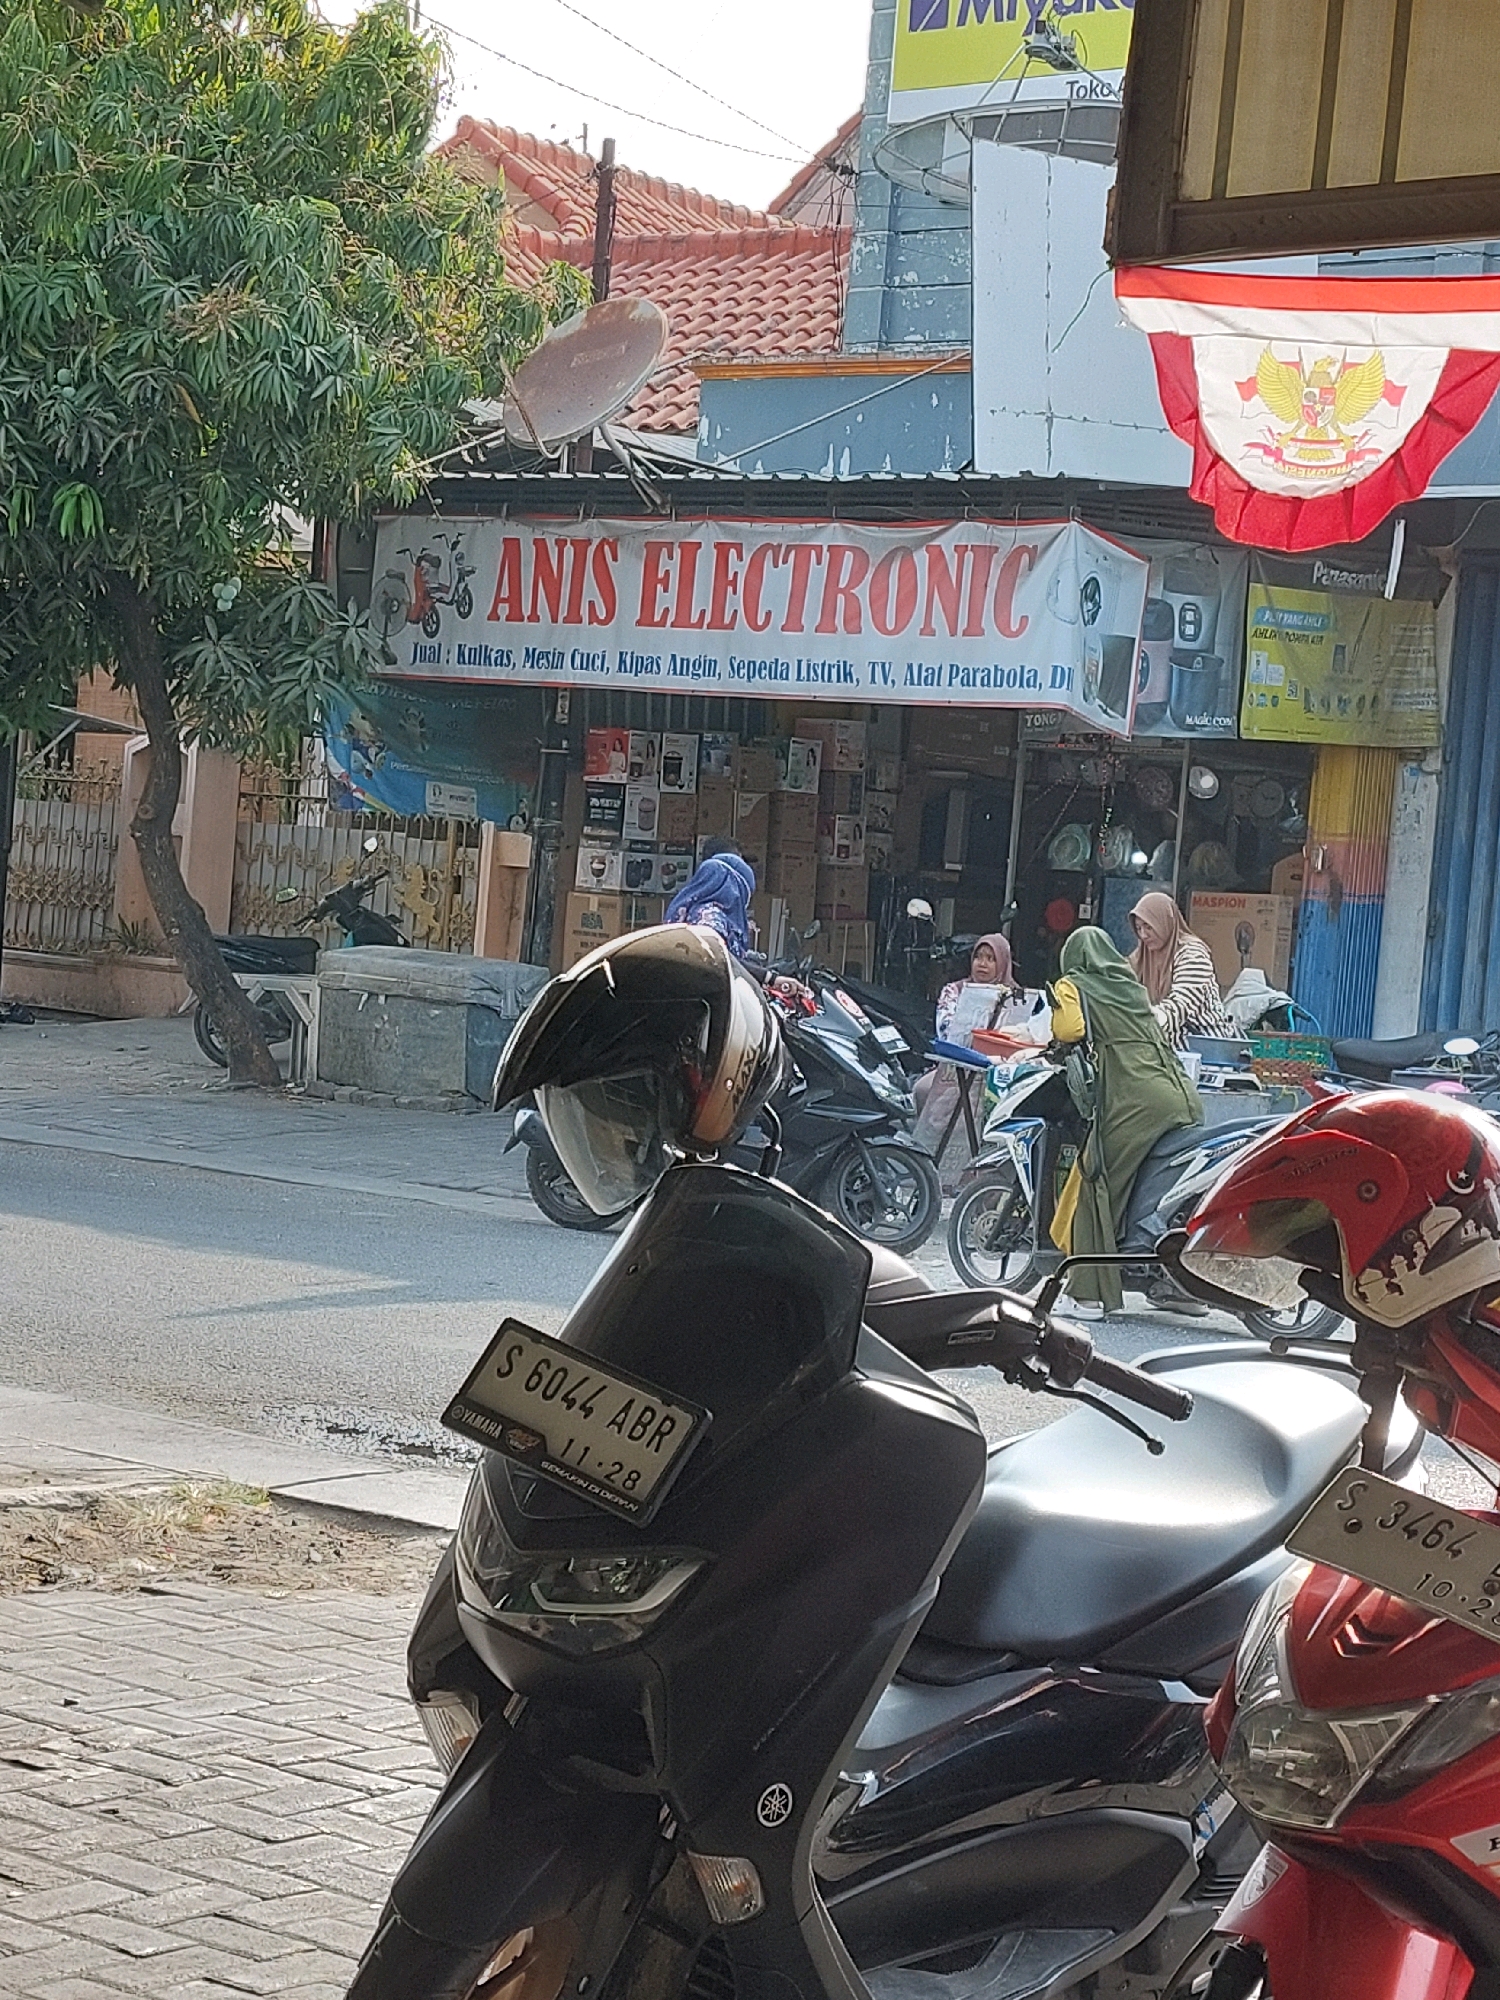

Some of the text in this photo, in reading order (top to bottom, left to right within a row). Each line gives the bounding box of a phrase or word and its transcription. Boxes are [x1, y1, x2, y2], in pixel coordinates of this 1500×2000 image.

[956, 0, 1135, 36] Miya
[1065, 79, 1113, 99] Toko
[486, 536, 1039, 639] ANIS ELECTRONIC
[1312, 560, 1387, 592] Panasonic
[410, 642, 442, 666] Jual
[456, 643, 517, 670] Kulkas,
[522, 646, 565, 671] Mesin
[570, 648, 611, 675] Cuci,
[616, 650, 662, 677] Kipas
[666, 653, 722, 681] Angin,
[728, 655, 790, 684] Sepeda
[796, 657, 861, 688] Listrik,
[868, 661, 896, 688] TV,
[904, 663, 943, 687] Alat
[947, 662, 1043, 692] Parabola,
[1192, 896, 1247, 909] MASPION
[496, 1344, 677, 1453] S 6044 ABR
[460, 1410, 503, 1439] YAMAHA
[1336, 1480, 1479, 1560] S 3464
